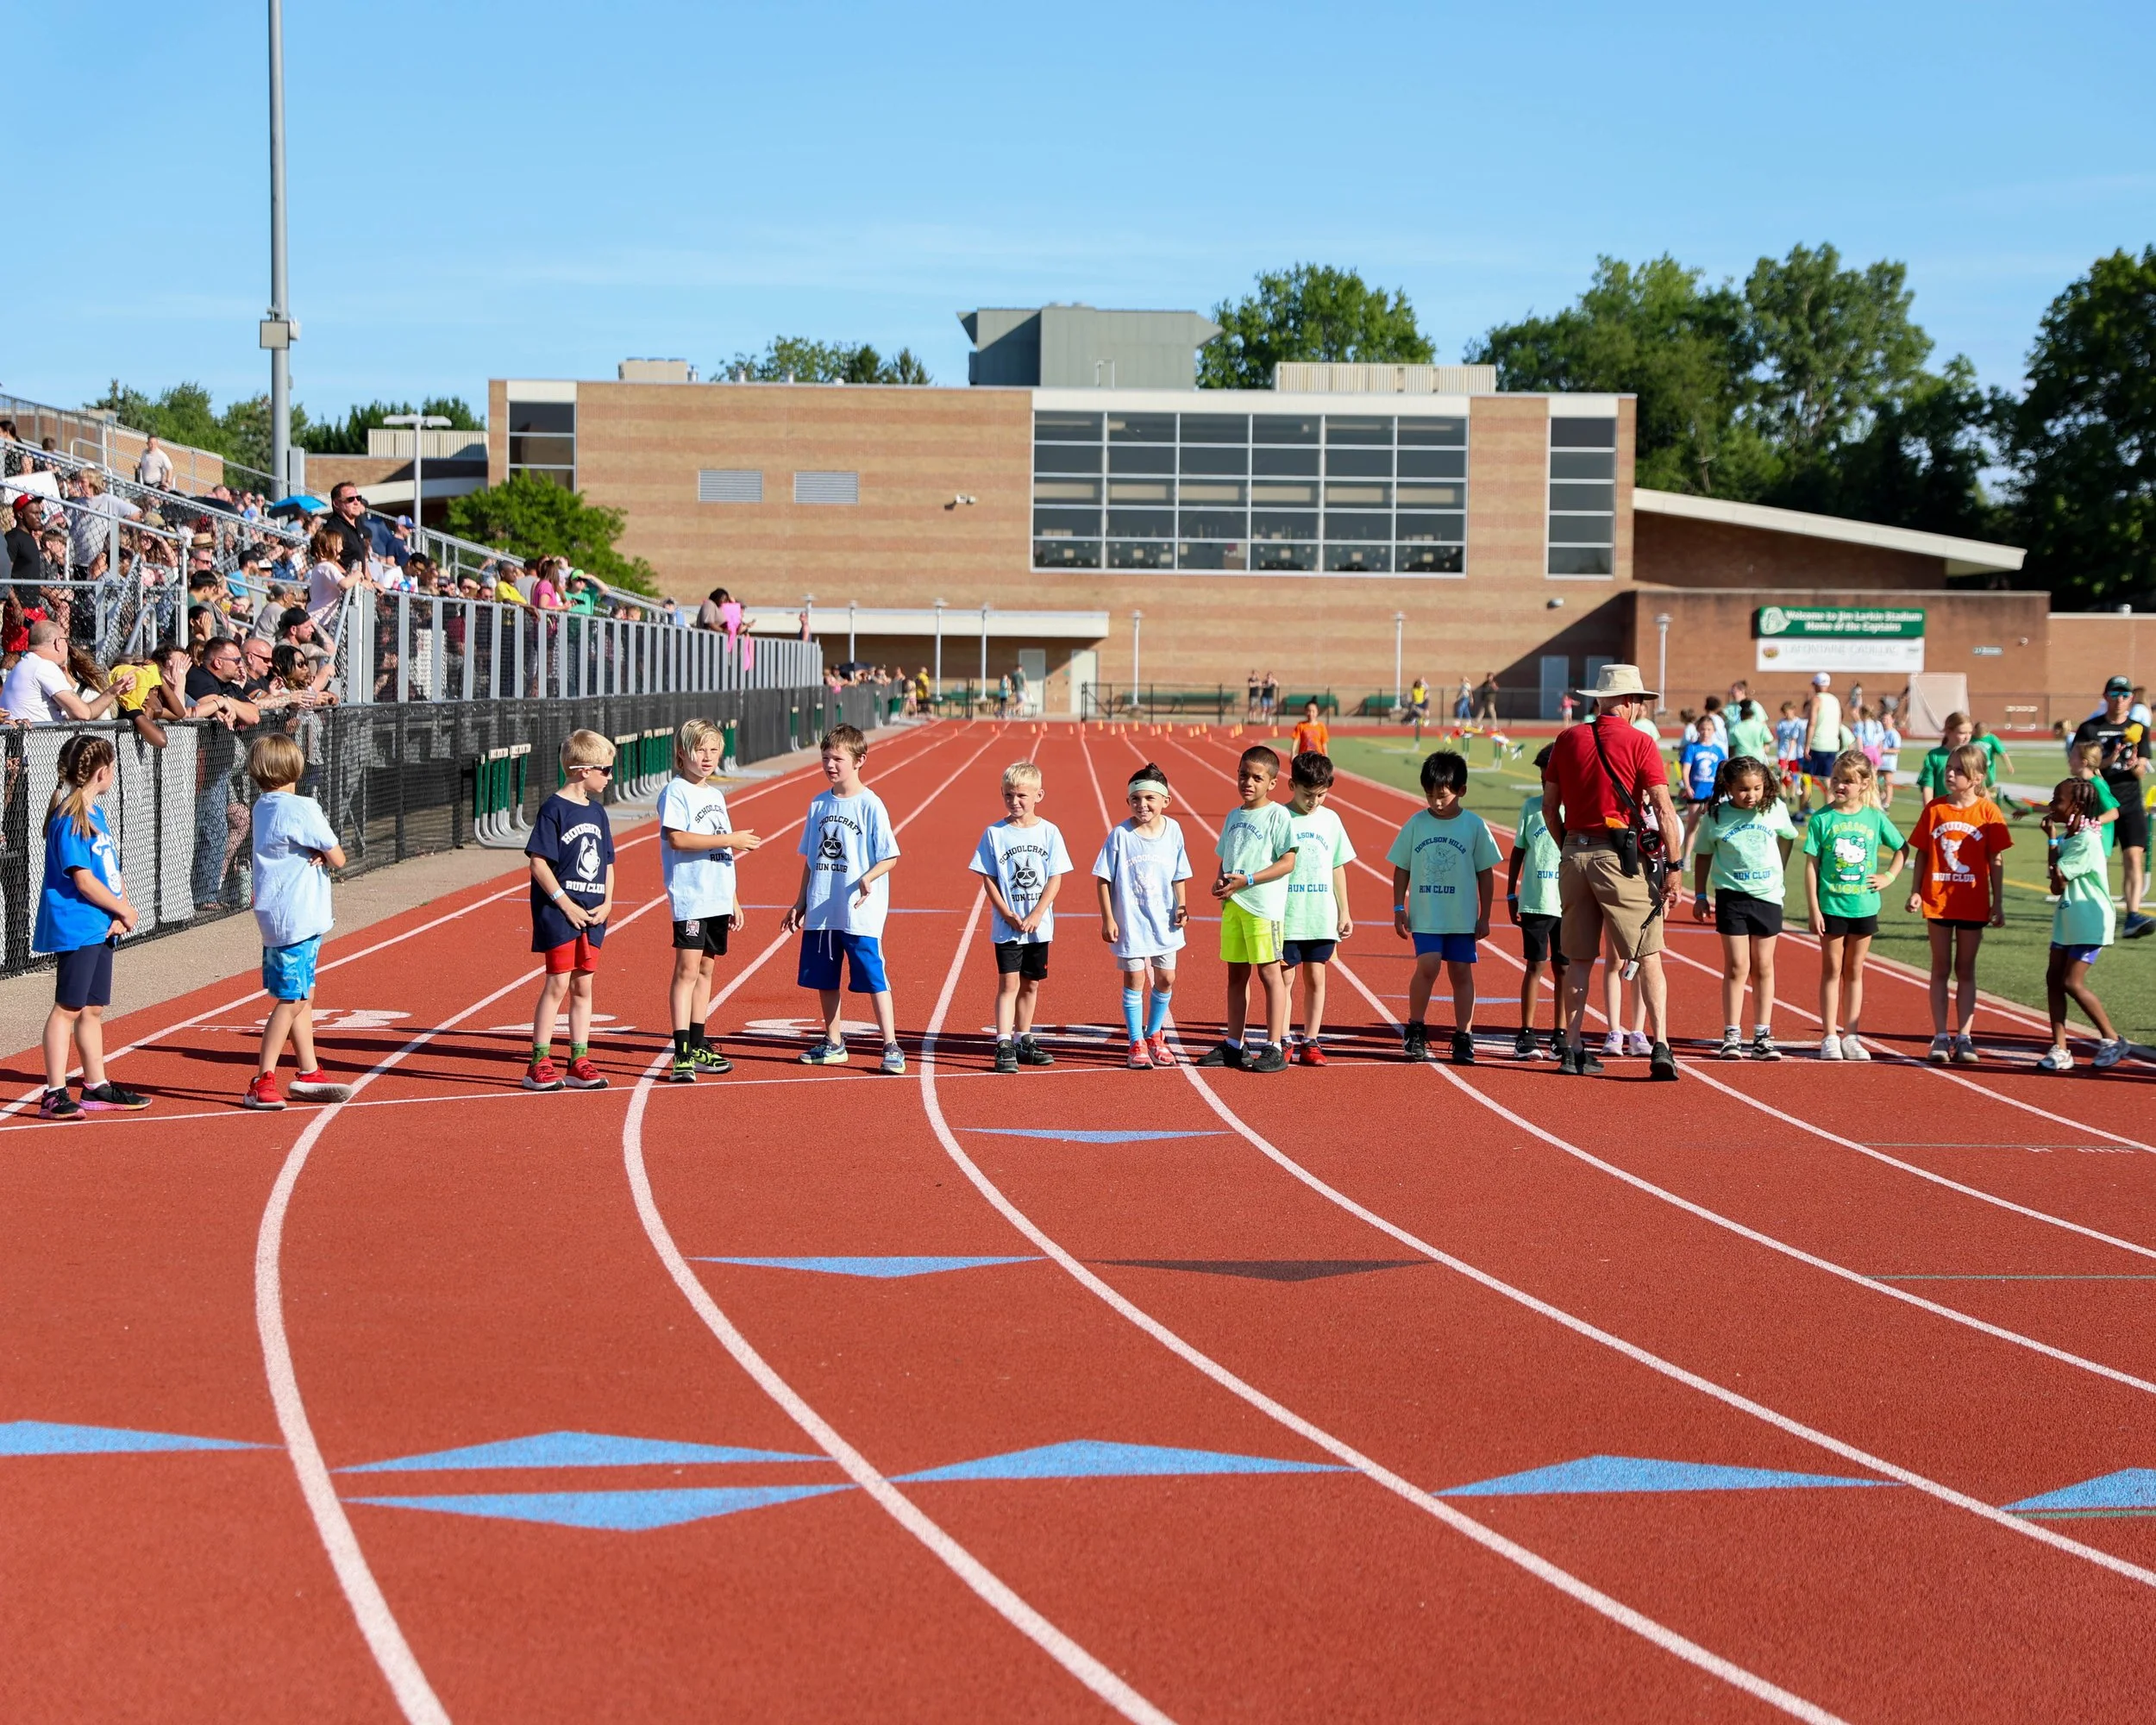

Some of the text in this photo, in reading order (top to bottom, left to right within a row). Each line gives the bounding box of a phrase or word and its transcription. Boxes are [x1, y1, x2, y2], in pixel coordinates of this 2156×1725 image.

[1785, 611, 1922, 622] Welcome to Jim Larkin Stadium
[1804, 622, 1902, 634] Home of the Captains
[1931, 821, 1984, 842] KNUDSEN
[1414, 837, 1467, 855] DONELSON HILLS
[830, 863, 849, 873] CLUB
[1537, 870, 1554, 879] RUN
[1733, 872, 1750, 881] RUN
[1932, 872, 1976, 883] RUN CLUB
[565, 881, 587, 892] RUN
[1288, 884, 1328, 893] RUN CLUB
[1419, 885, 1456, 894] RUN CLUB
